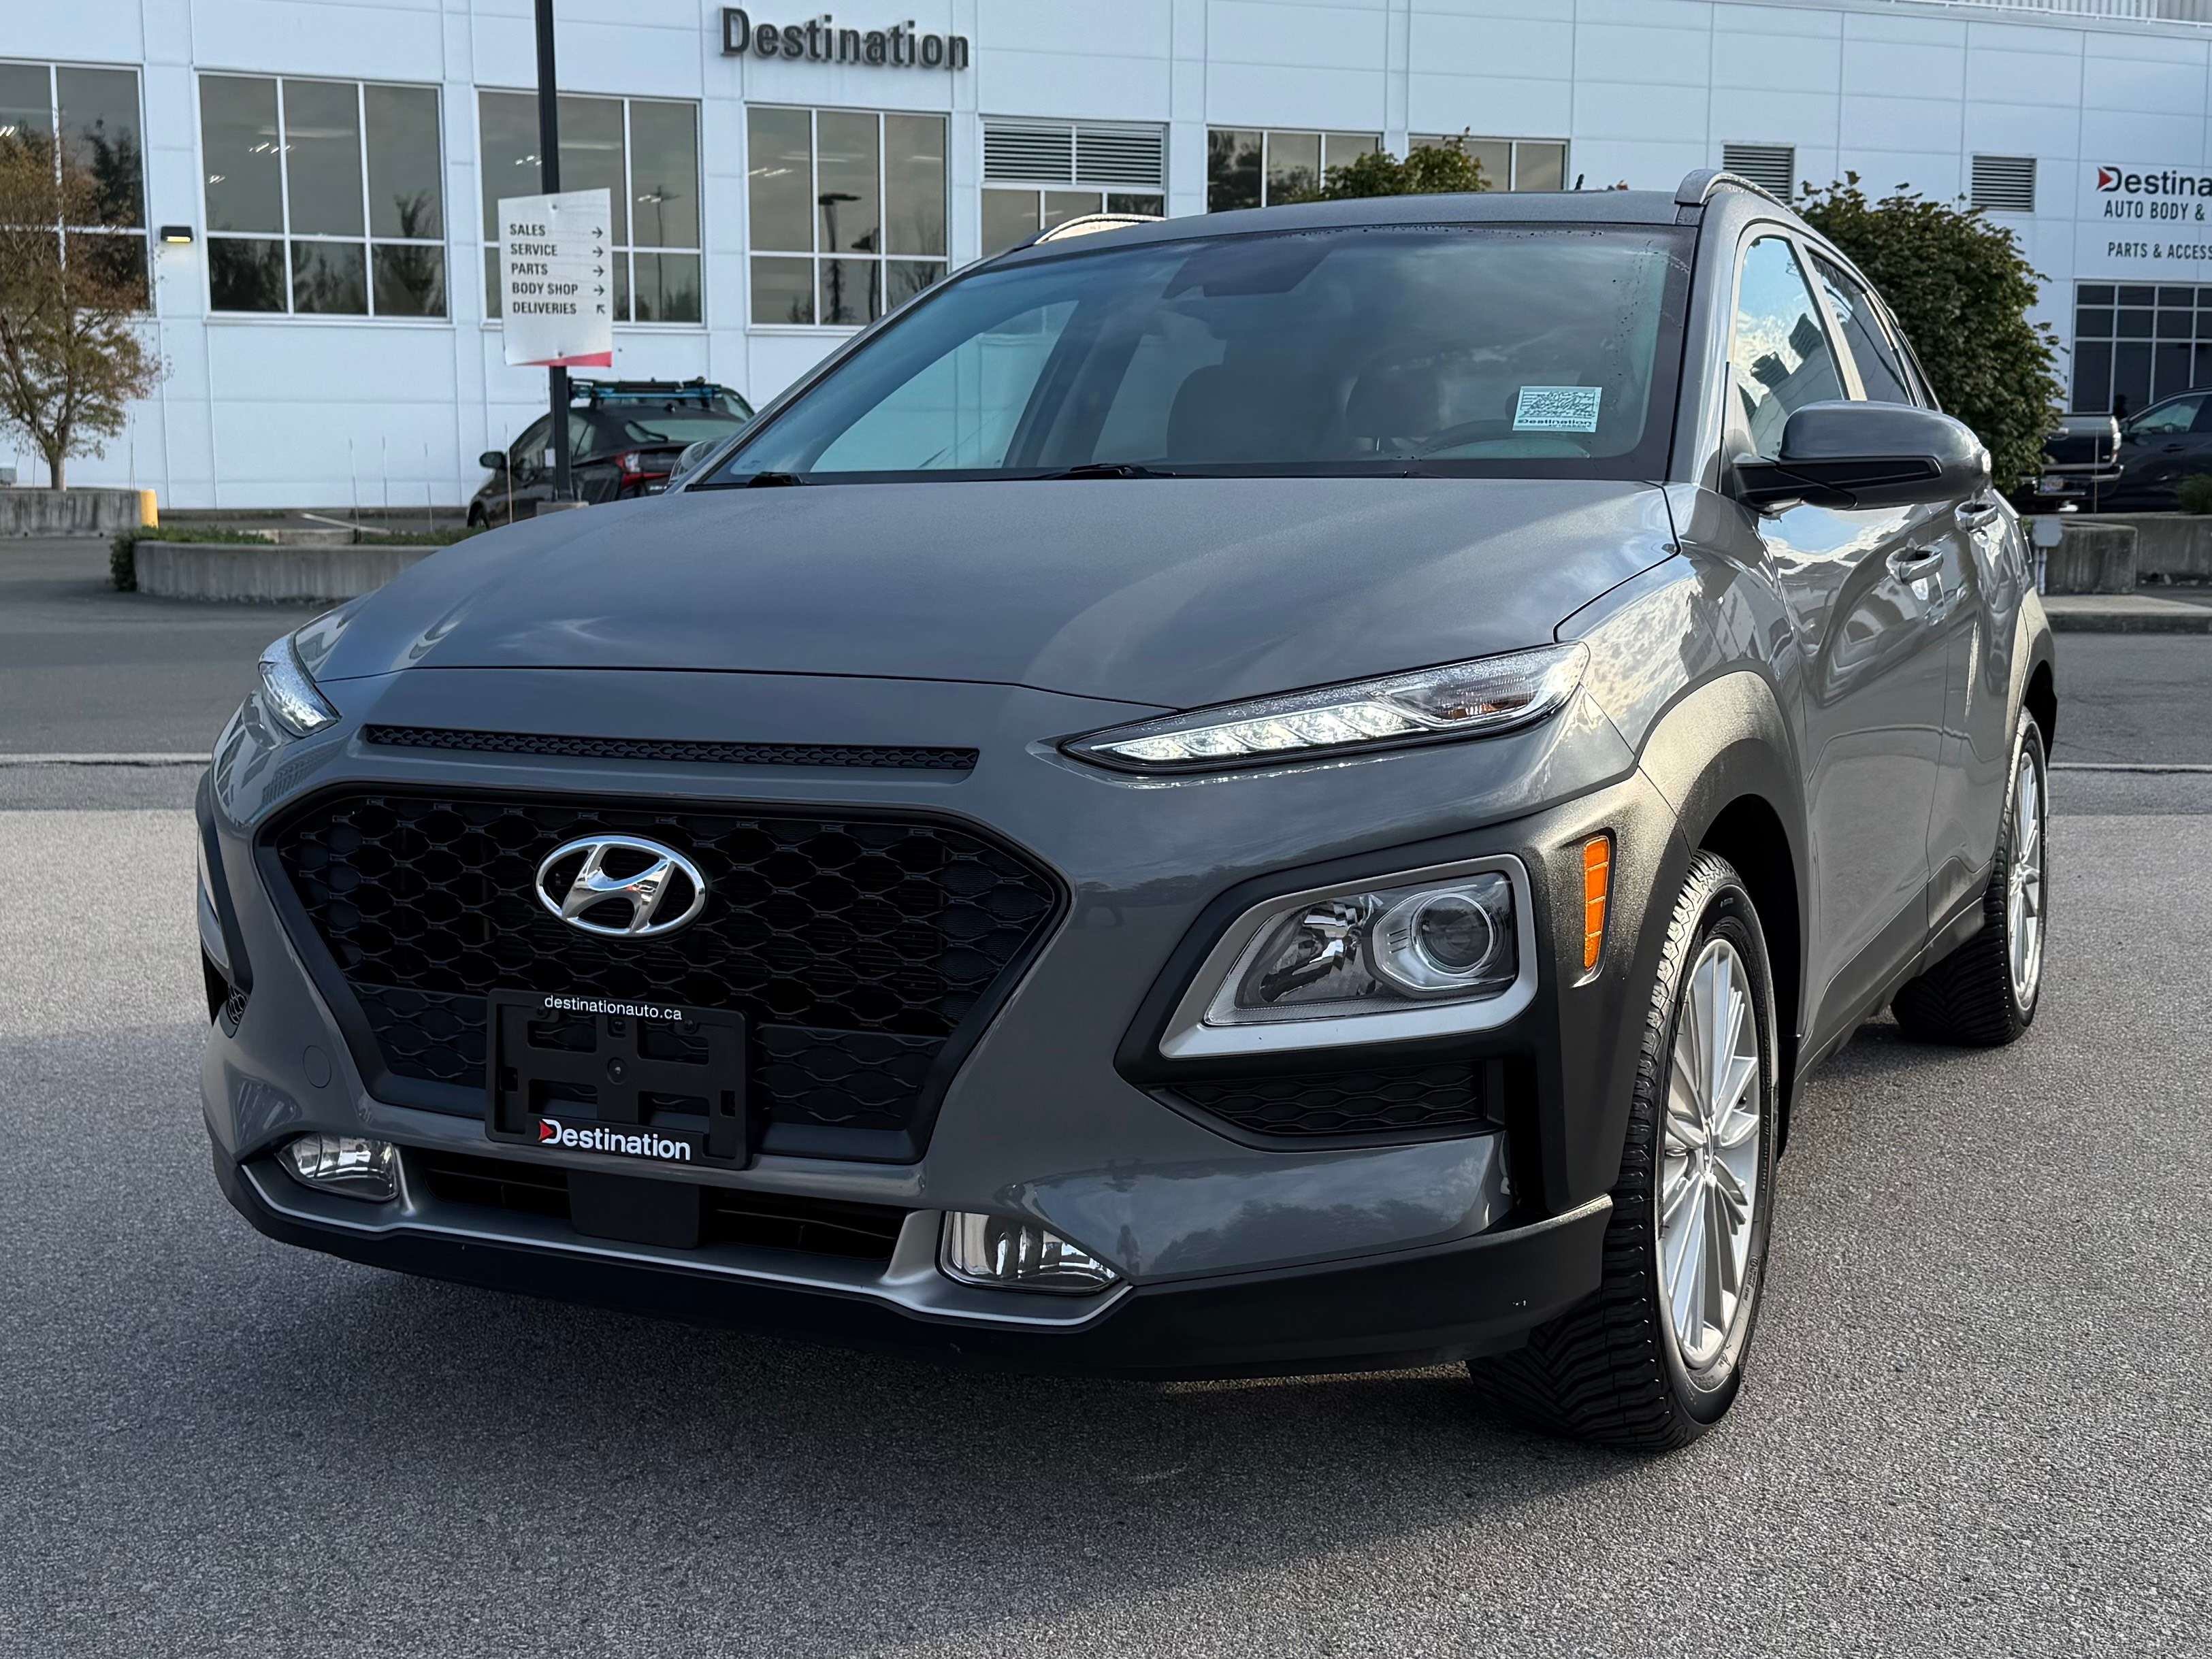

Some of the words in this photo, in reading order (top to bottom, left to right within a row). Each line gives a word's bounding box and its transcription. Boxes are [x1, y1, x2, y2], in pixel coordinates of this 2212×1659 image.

[720, 7, 969, 69] Destination
[2096, 166, 2212, 197] Destina
[2104, 200, 2143, 218] AUTO
[2150, 202, 2189, 220] BODY
[2195, 203, 2205, 221] &
[510, 224, 545, 237] SALES
[510, 244, 557, 257] SERVICE
[2108, 242, 2147, 258] PARTS
[2153, 244, 2162, 259] &
[512, 263, 548, 276] PARTS
[513, 282, 544, 295] BODY
[547, 282, 578, 295] SHOP
[513, 302, 576, 314] DELIVERIES
[544, 995, 682, 1020] destinationauto.ca
[538, 1118, 691, 1160] Destination
